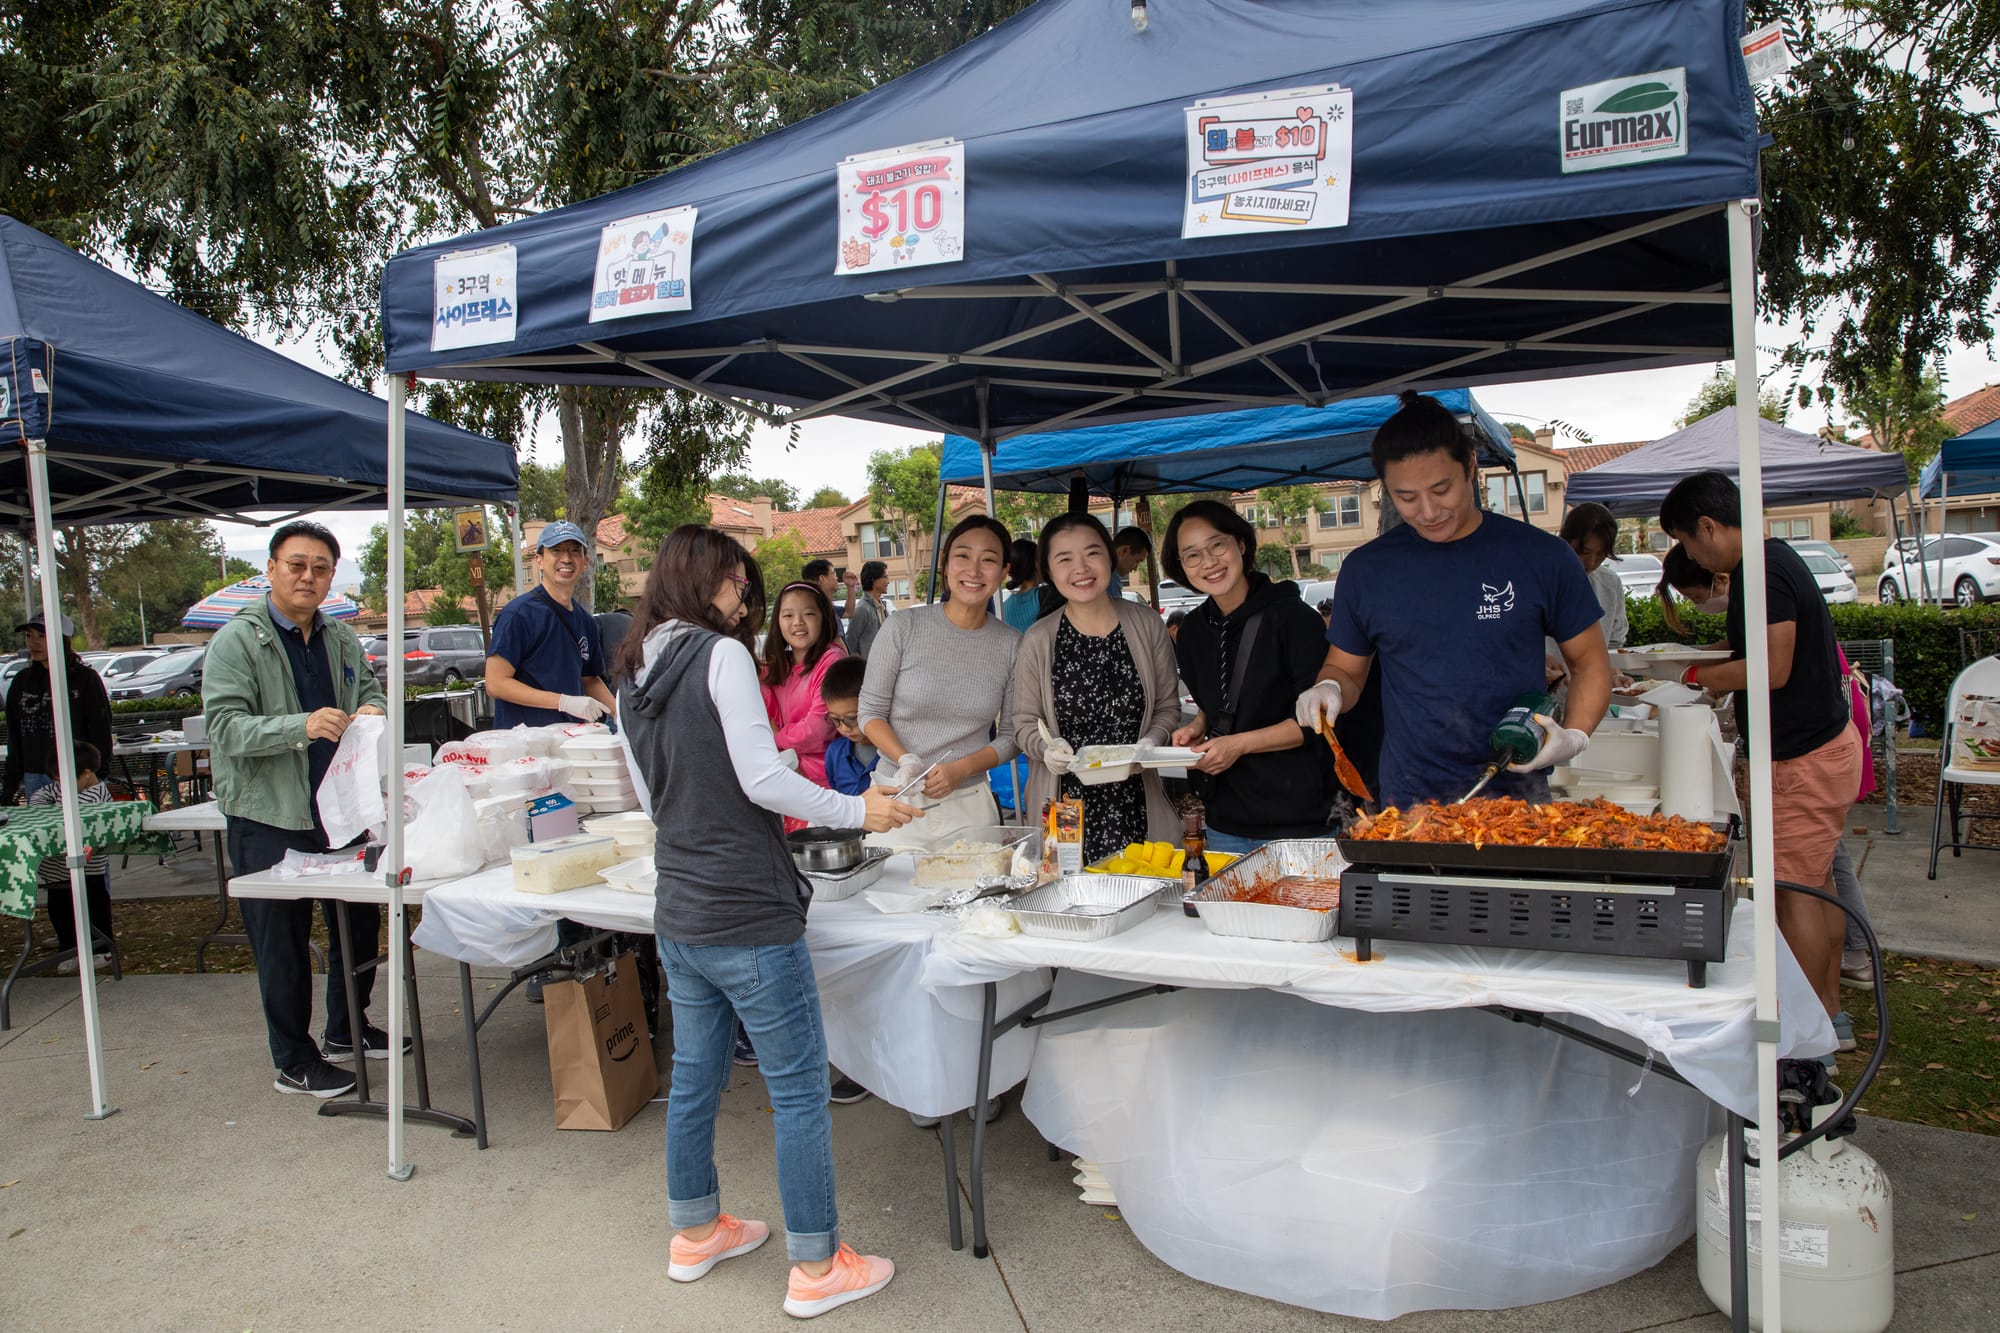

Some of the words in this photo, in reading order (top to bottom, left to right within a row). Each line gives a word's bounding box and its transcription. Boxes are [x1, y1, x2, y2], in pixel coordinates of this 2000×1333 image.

[1275, 125, 1315, 148] $10
[1565, 111, 1672, 152] Eurmax
[1292, 160, 1313, 174] 음식
[861, 184, 942, 240] $10
[458, 273, 490, 295] 3구역
[436, 297, 513, 328] 사이프레스
[1476, 605, 1501, 614] JHS
[606, 1021, 635, 1056] prime
